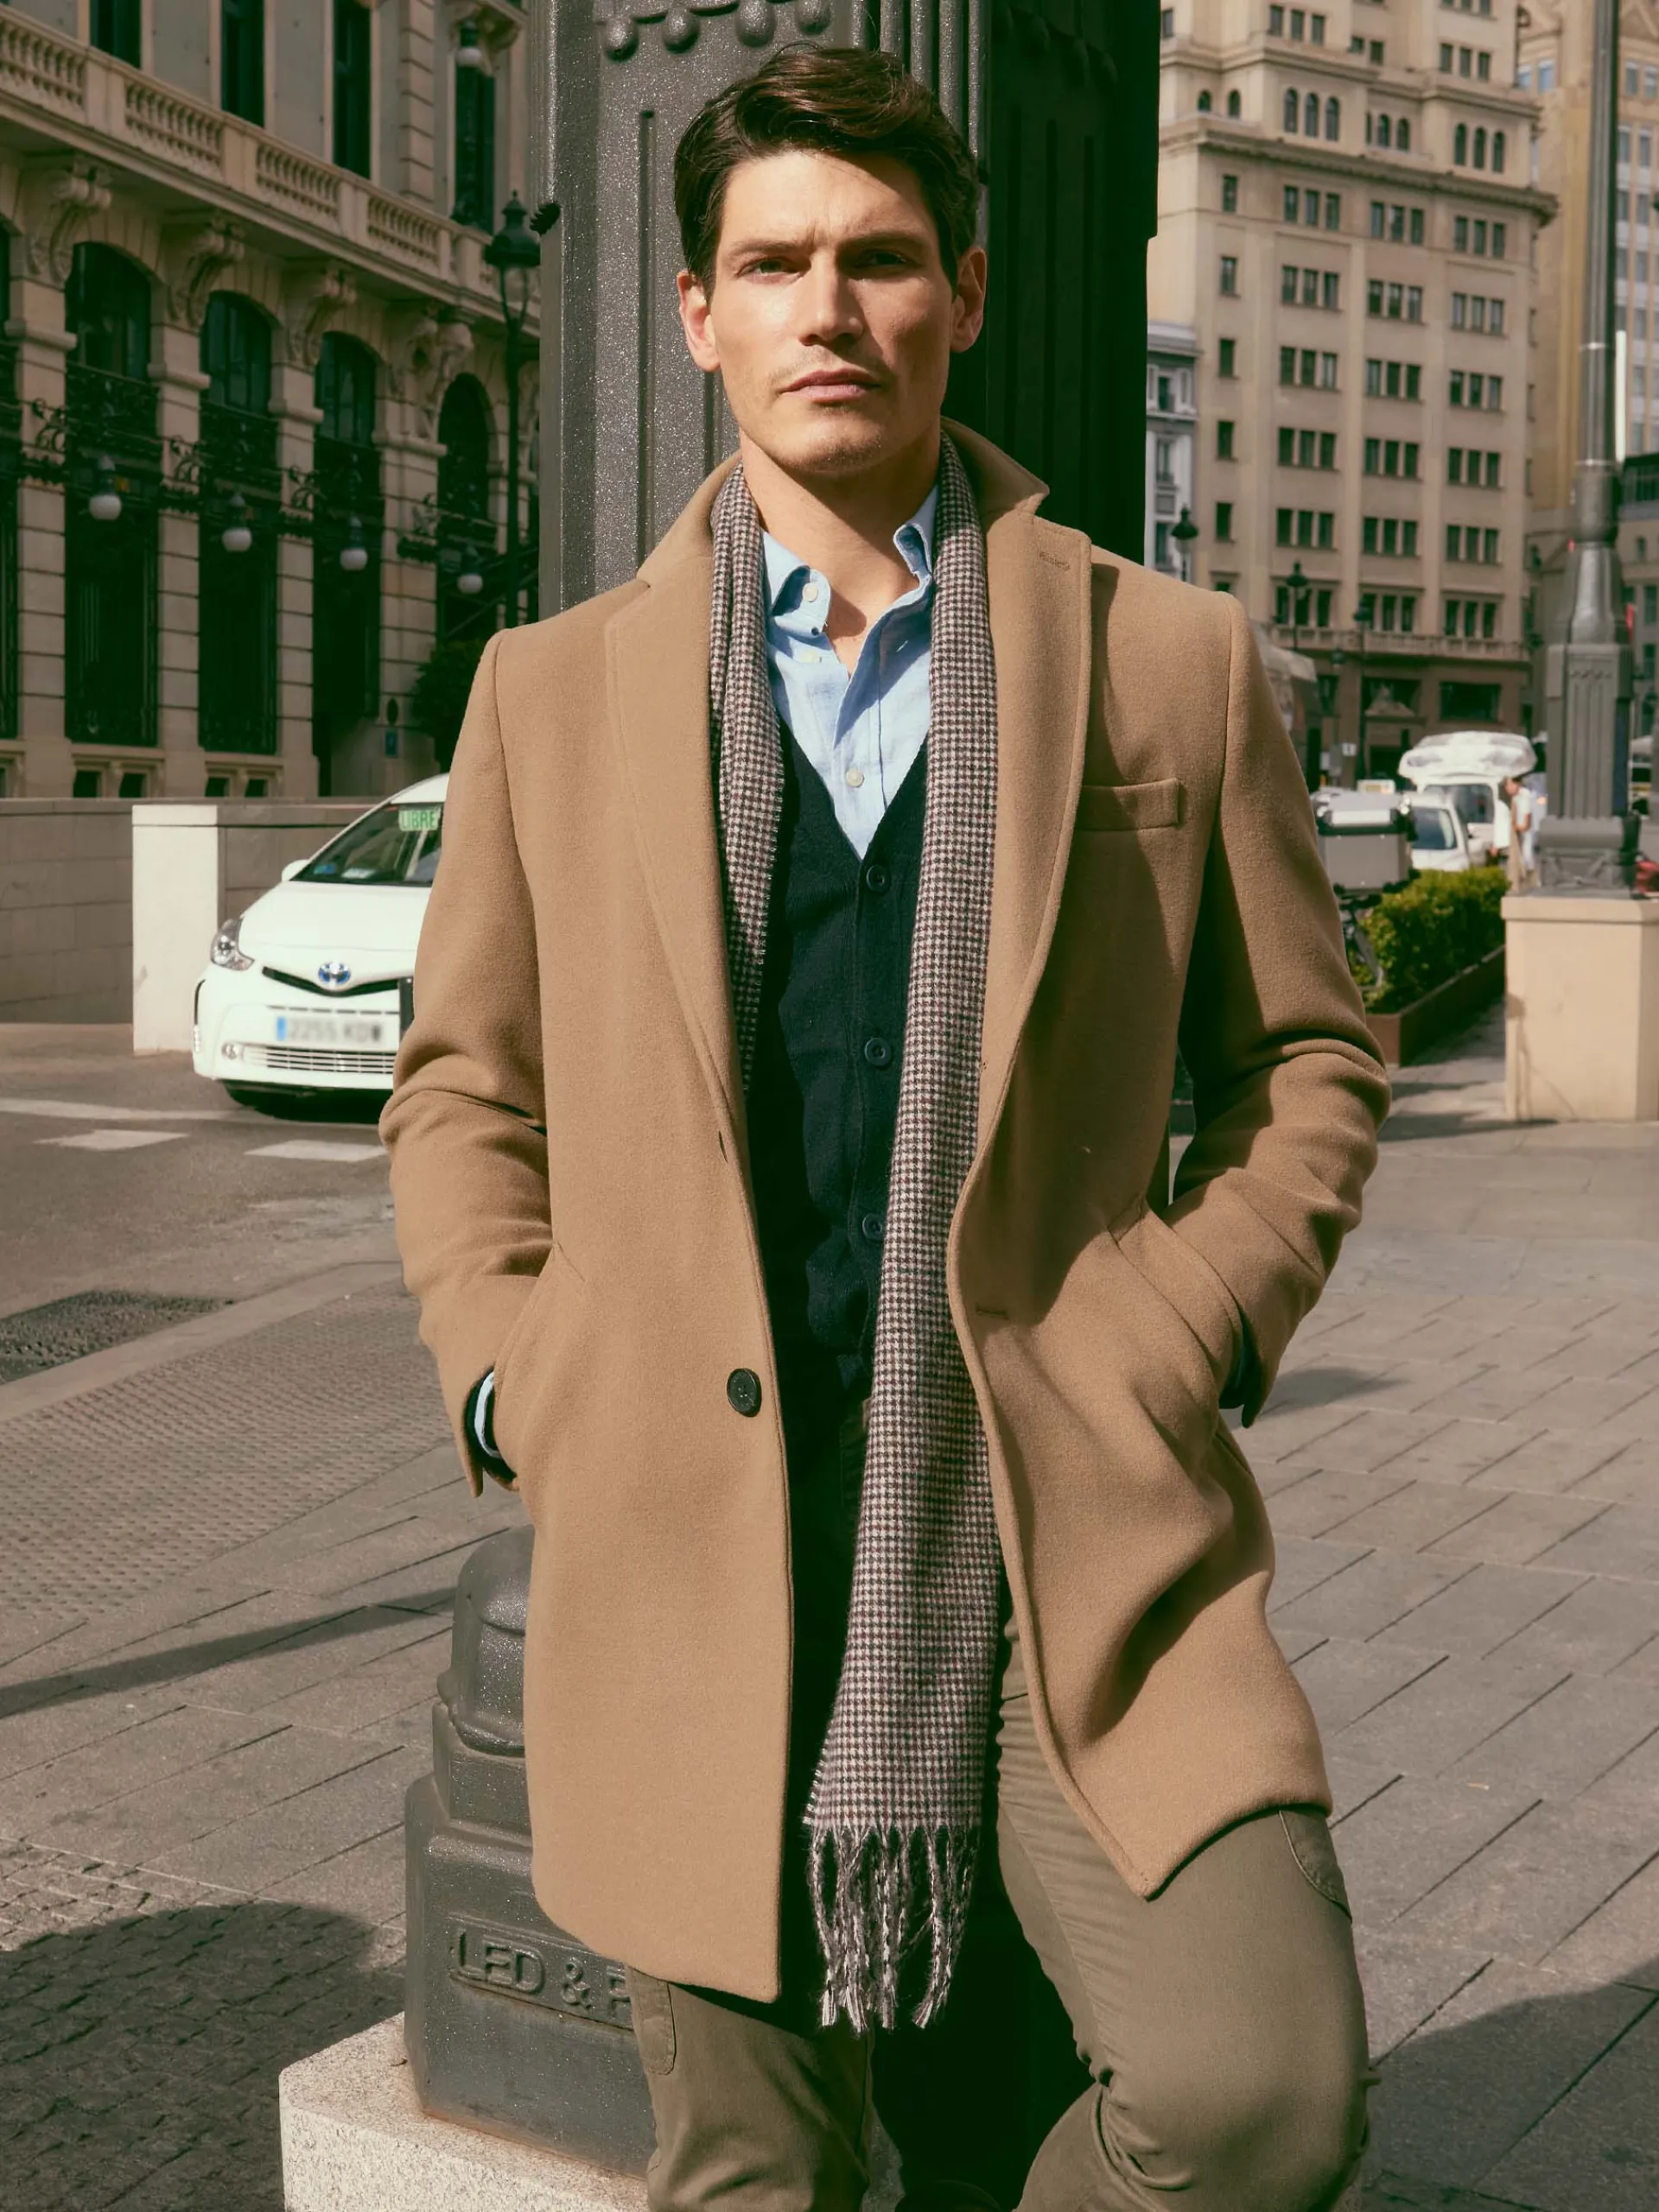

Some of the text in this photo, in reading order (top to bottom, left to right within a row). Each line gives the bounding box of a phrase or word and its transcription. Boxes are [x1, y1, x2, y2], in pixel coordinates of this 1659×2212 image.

[401, 810, 437, 828] LIBRE
[455, 1928, 546, 1994] LED
[562, 1956, 593, 2009] &
